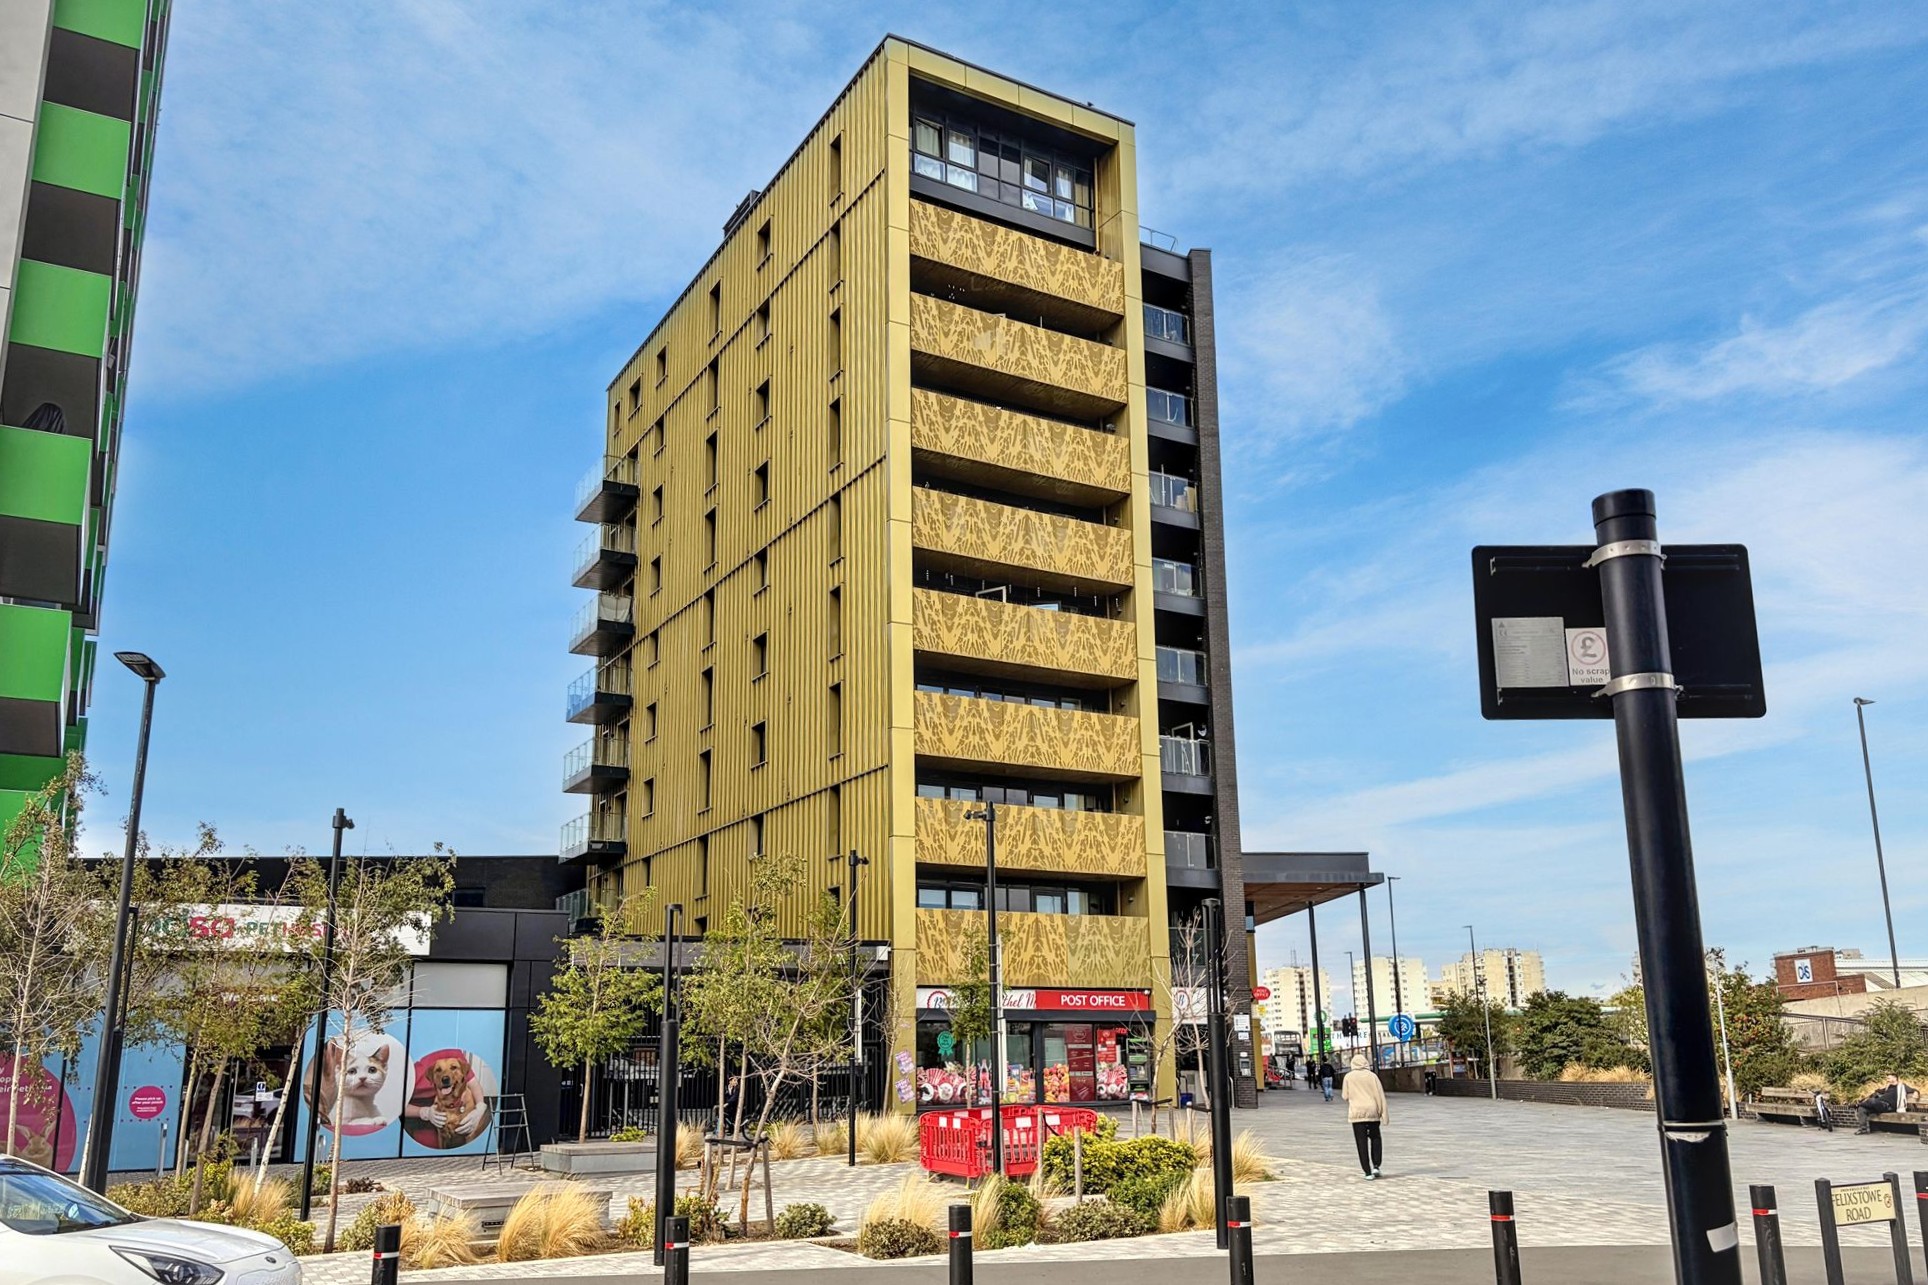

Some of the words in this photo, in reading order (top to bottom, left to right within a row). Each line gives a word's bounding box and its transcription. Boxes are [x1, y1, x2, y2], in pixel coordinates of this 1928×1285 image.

[1572, 668, 1584, 676] No
[1586, 668, 1610, 676] scrap
[1580, 676, 1603, 684] value
[1061, 994, 1087, 1006] POST
[1089, 995, 1126, 1006] OFFICE
[1846, 1206, 1872, 1222] ROAD
